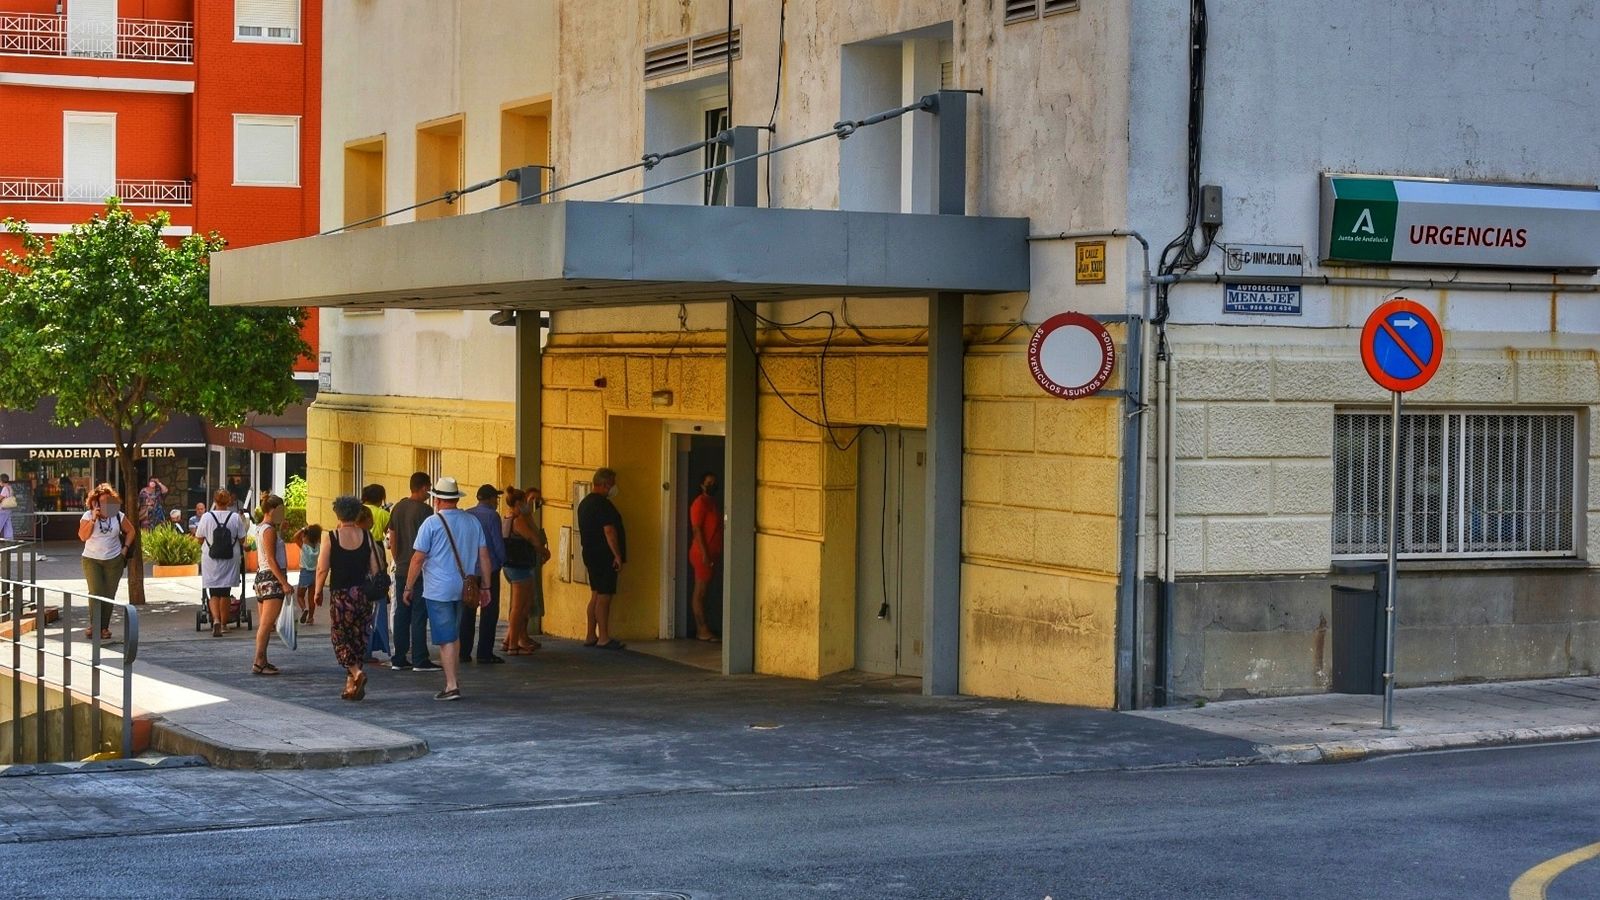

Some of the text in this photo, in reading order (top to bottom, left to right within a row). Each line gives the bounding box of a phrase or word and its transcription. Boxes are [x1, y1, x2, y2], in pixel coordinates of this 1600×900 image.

[1409, 225, 1527, 248] URGENCIAS
[1085, 249, 1099, 259] CALLE
[1252, 252, 1302, 266] INMACULADA
[1237, 284, 1290, 292] AUTOESCUELA
[1228, 291, 1295, 305] MENA-JEF
[1030, 327, 1114, 396] SALVO VEHICULOS ASUNTOS SANITARIOS
